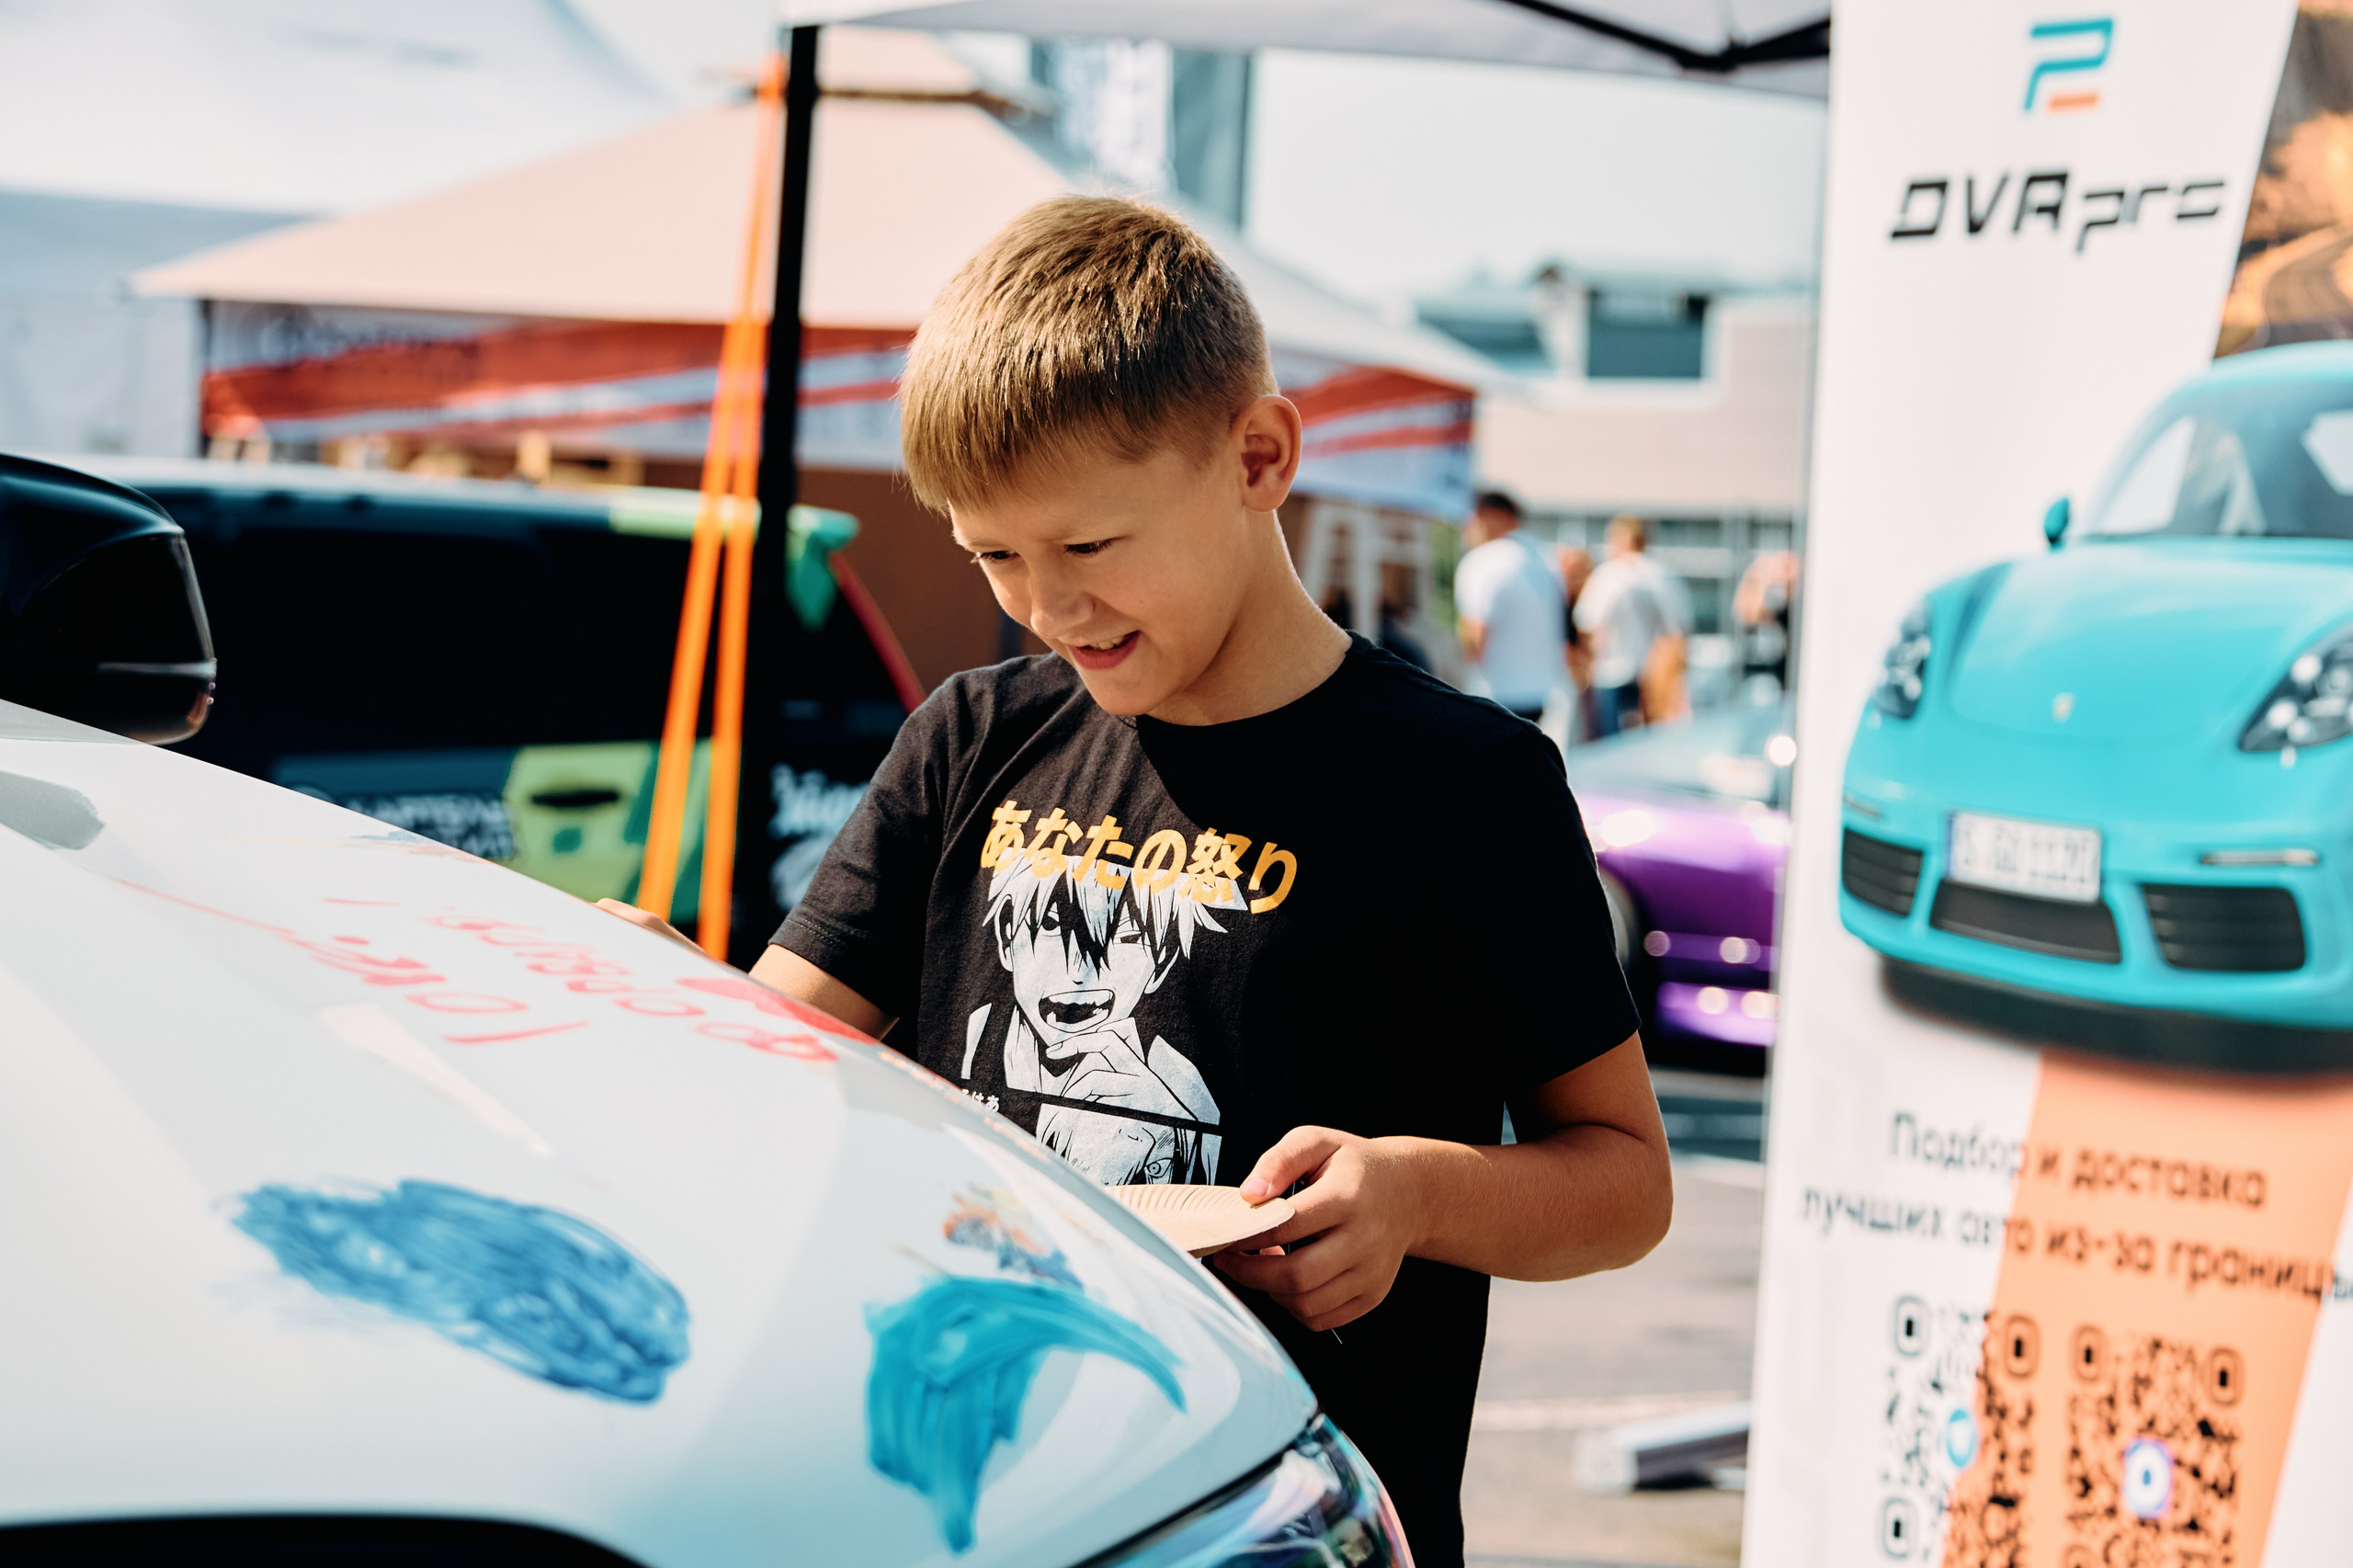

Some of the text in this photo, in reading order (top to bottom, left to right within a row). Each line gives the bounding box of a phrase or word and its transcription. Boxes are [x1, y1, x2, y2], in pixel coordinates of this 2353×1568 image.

[980, 800, 1298, 915] あなたの怒り
[1892, 1111, 2268, 1209] Подбор и доставка
[1802, 1188, 1943, 1237] лучших
[1960, 1209, 2035, 1255] авто
[2046, 1225, 2155, 1273] из-за
